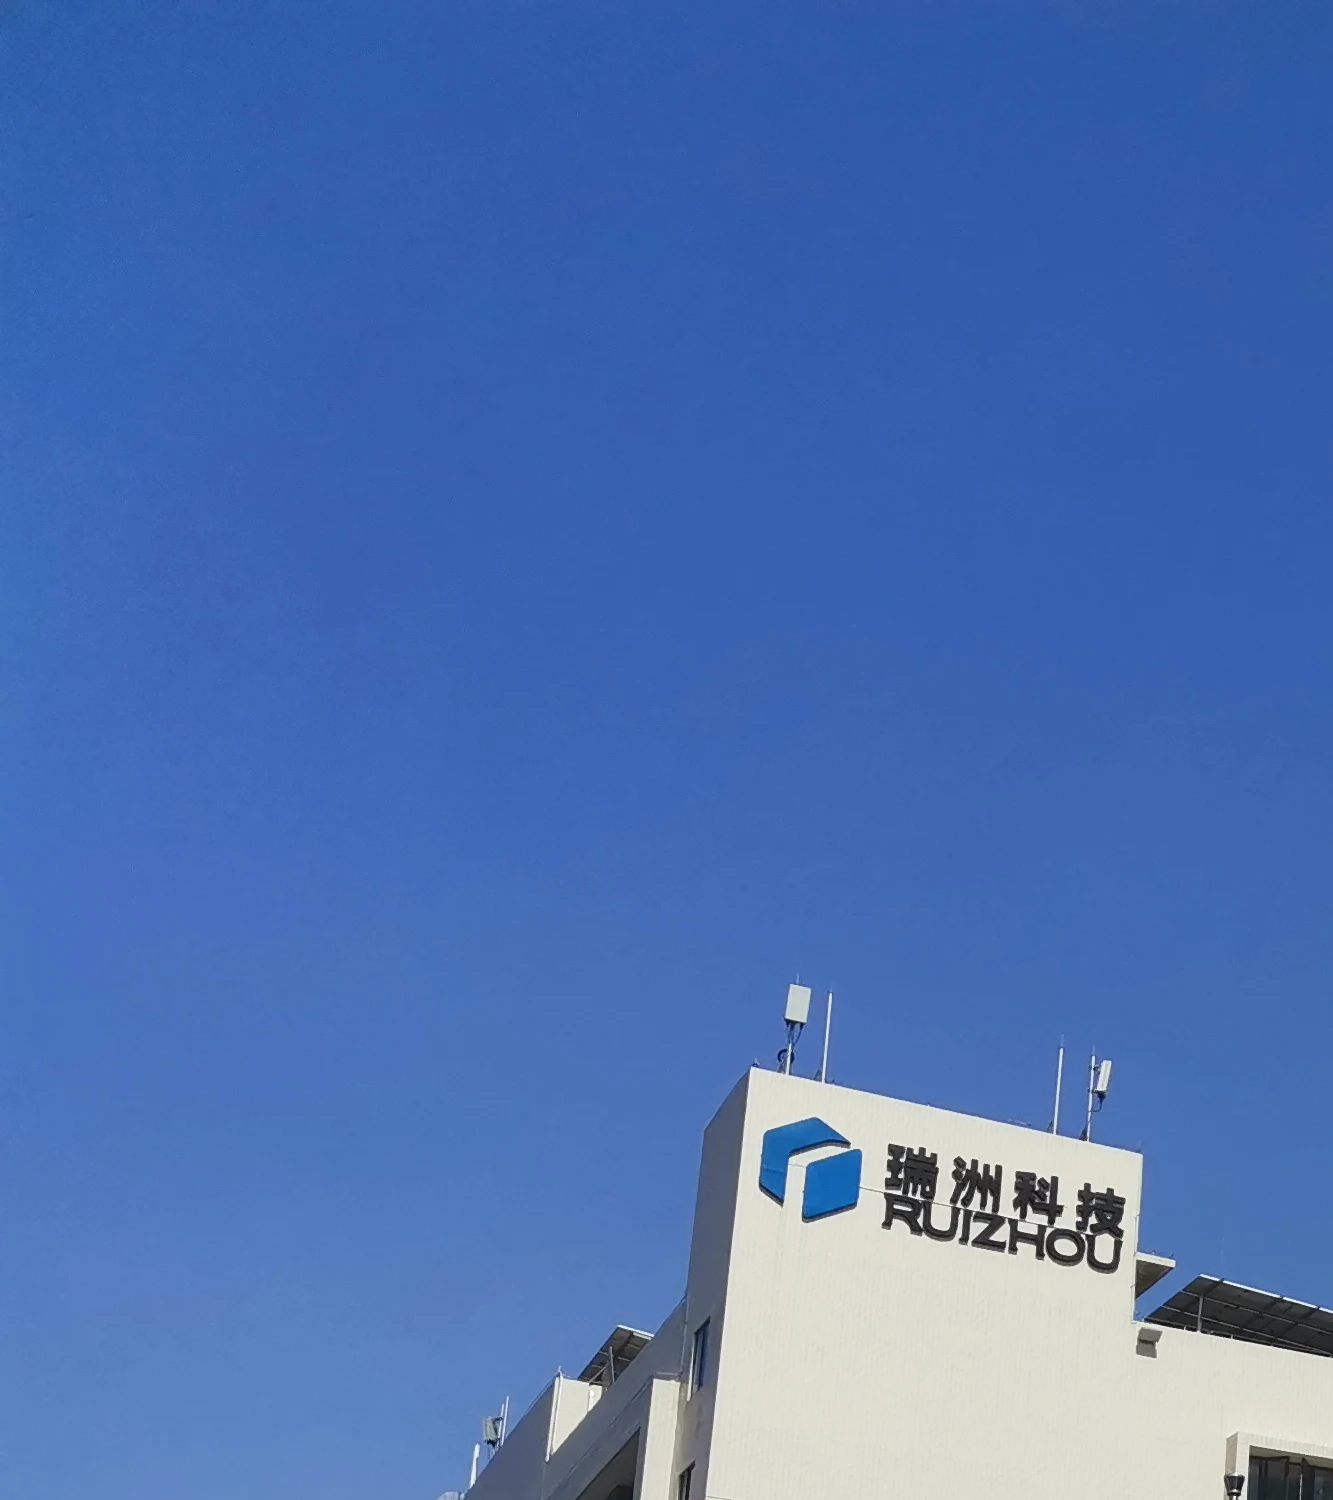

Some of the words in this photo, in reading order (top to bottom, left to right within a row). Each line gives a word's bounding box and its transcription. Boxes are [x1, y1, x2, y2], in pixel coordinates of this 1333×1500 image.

[881, 1193, 1124, 1274] RUIZHOU
[885, 1143, 1126, 1239] 瑞洲科技
